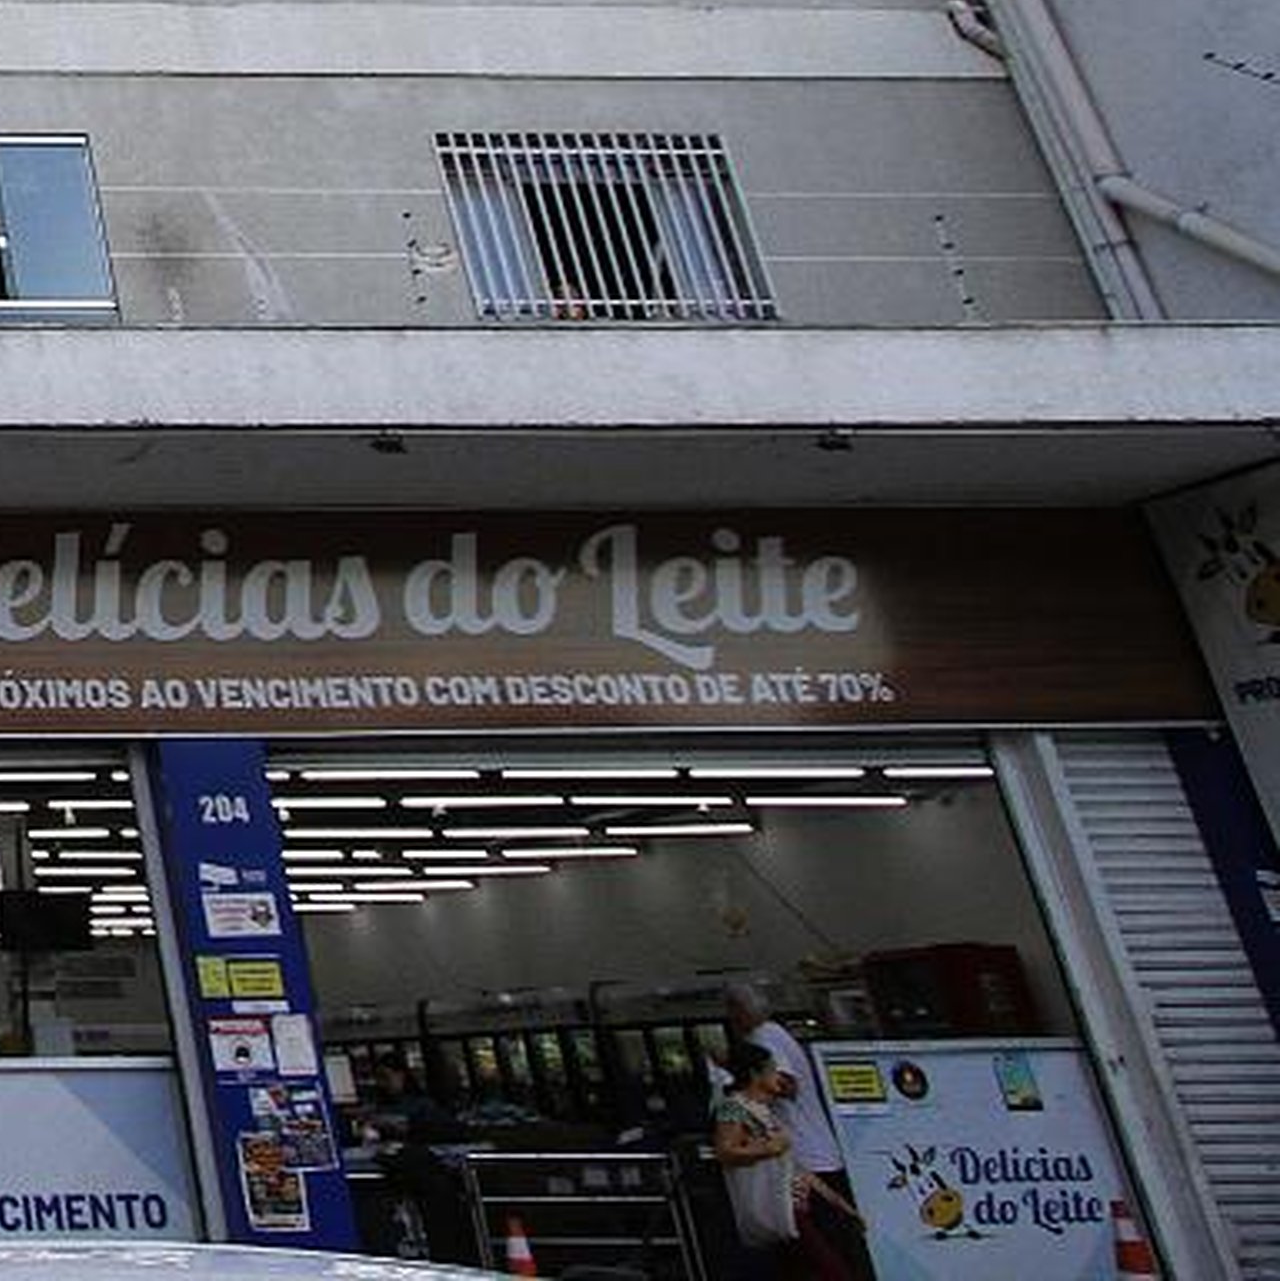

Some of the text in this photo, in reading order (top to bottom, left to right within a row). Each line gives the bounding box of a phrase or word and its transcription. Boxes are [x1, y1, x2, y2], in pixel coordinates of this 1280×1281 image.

[403, 531, 566, 636] do
[578, 524, 860, 671] Leite
[140, 677, 188, 709] AO
[193, 675, 419, 709] VENCIMENTO
[425, 675, 501, 707] COM
[507, 673, 689, 706] DESCONTO
[695, 673, 746, 704] DE
[751, 666, 814, 704] ATÉ
[819, 672, 895, 702] 70%
[198, 793, 251, 823] 204
[974, 1187, 1104, 1235] do Leite
